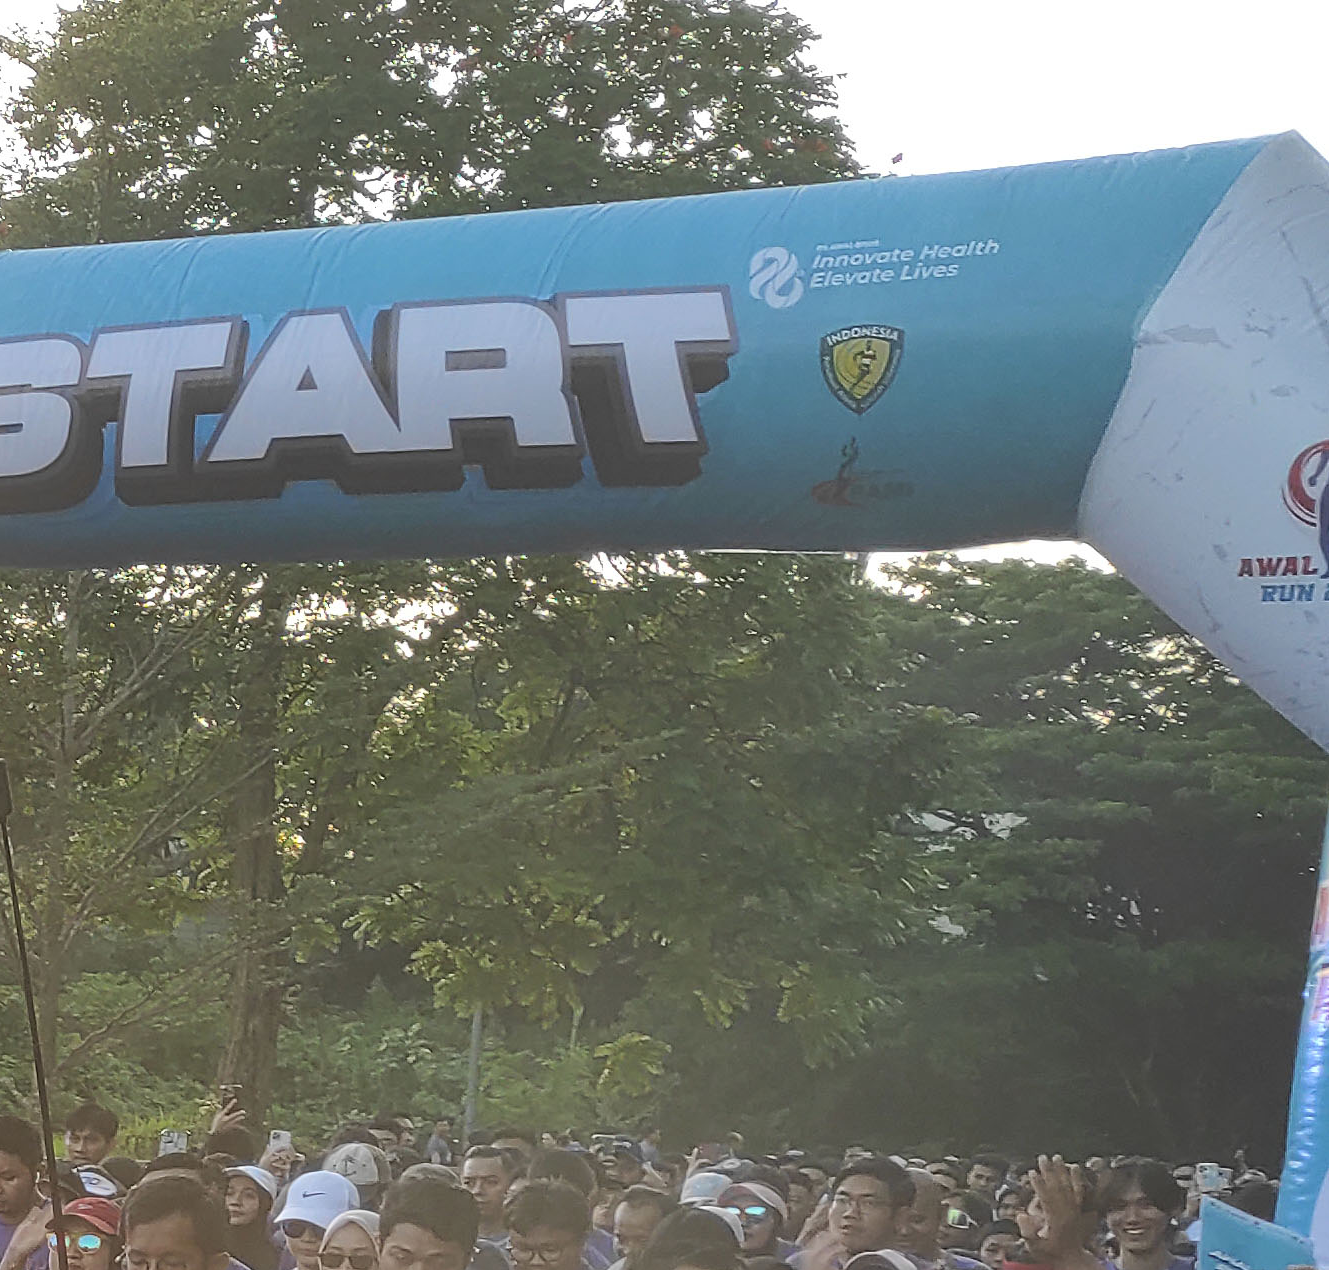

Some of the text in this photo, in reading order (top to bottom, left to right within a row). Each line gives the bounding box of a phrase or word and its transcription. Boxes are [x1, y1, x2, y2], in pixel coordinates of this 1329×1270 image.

[812, 239, 1001, 269] Innovate Health
[809, 262, 960, 288] Elevate Lives
[826, 326, 899, 346] INDONESIA
[1237, 556, 1319, 577] AWAL
[1261, 583, 1315, 602] RUN
